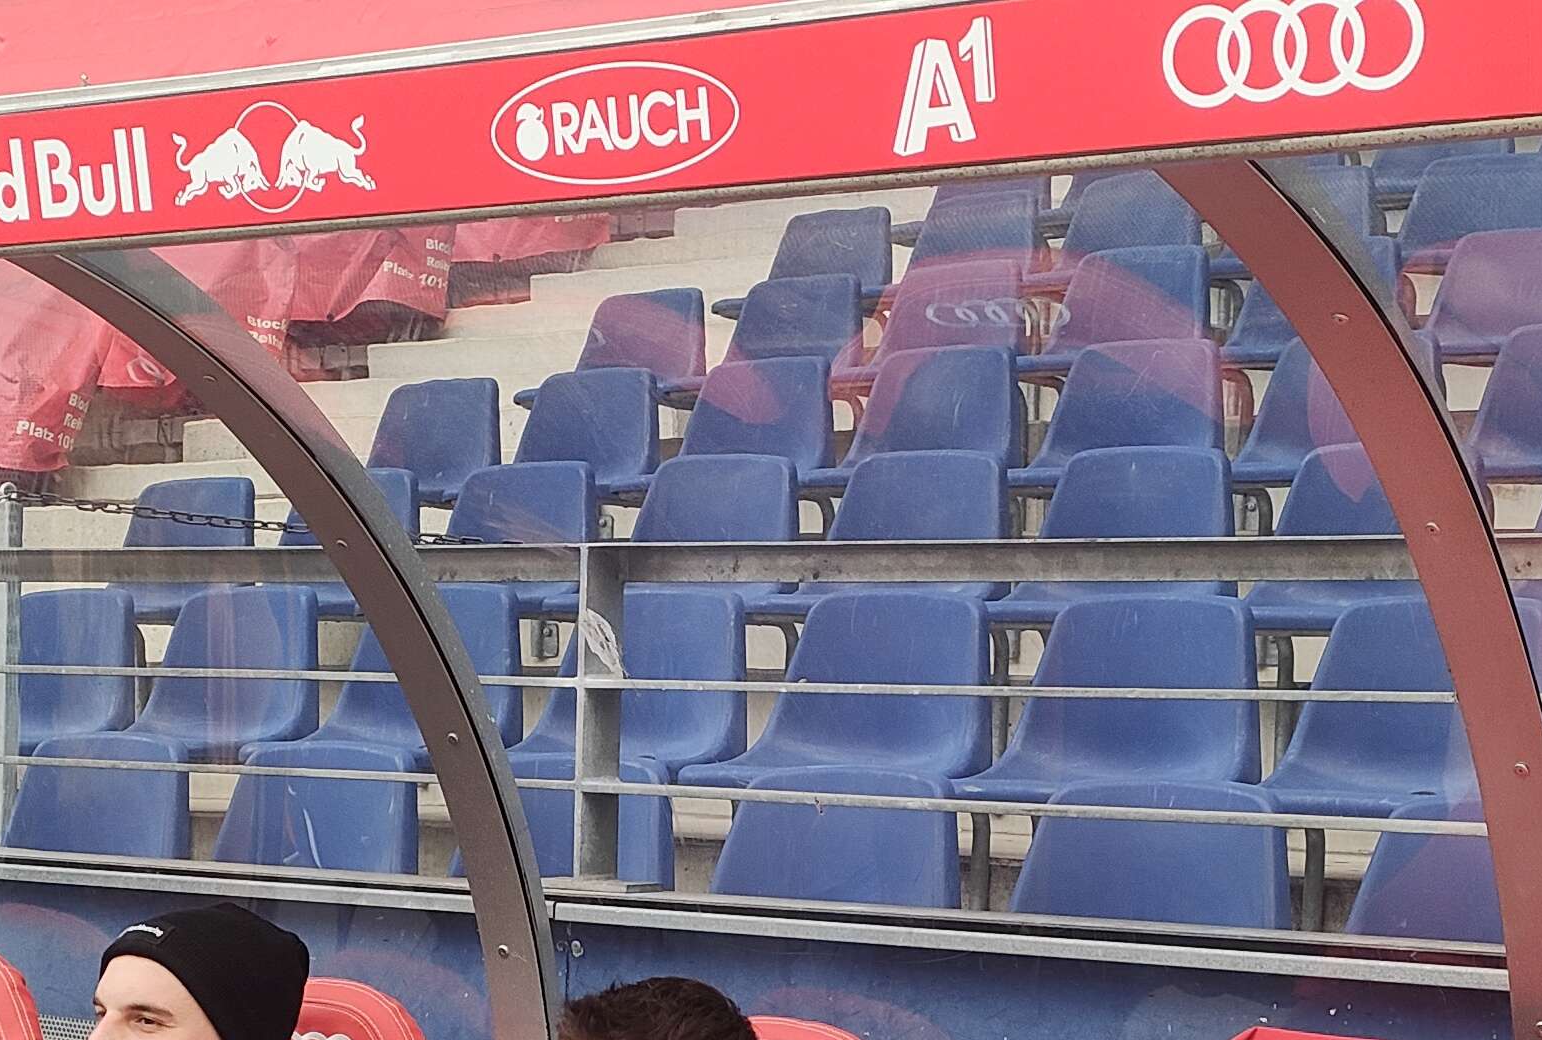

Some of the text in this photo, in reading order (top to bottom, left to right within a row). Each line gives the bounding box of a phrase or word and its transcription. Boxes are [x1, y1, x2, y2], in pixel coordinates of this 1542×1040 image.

[551, 86, 711, 156] RAUCH
[892, 16, 996, 157] A1
[16, 420, 55, 443] Platz
